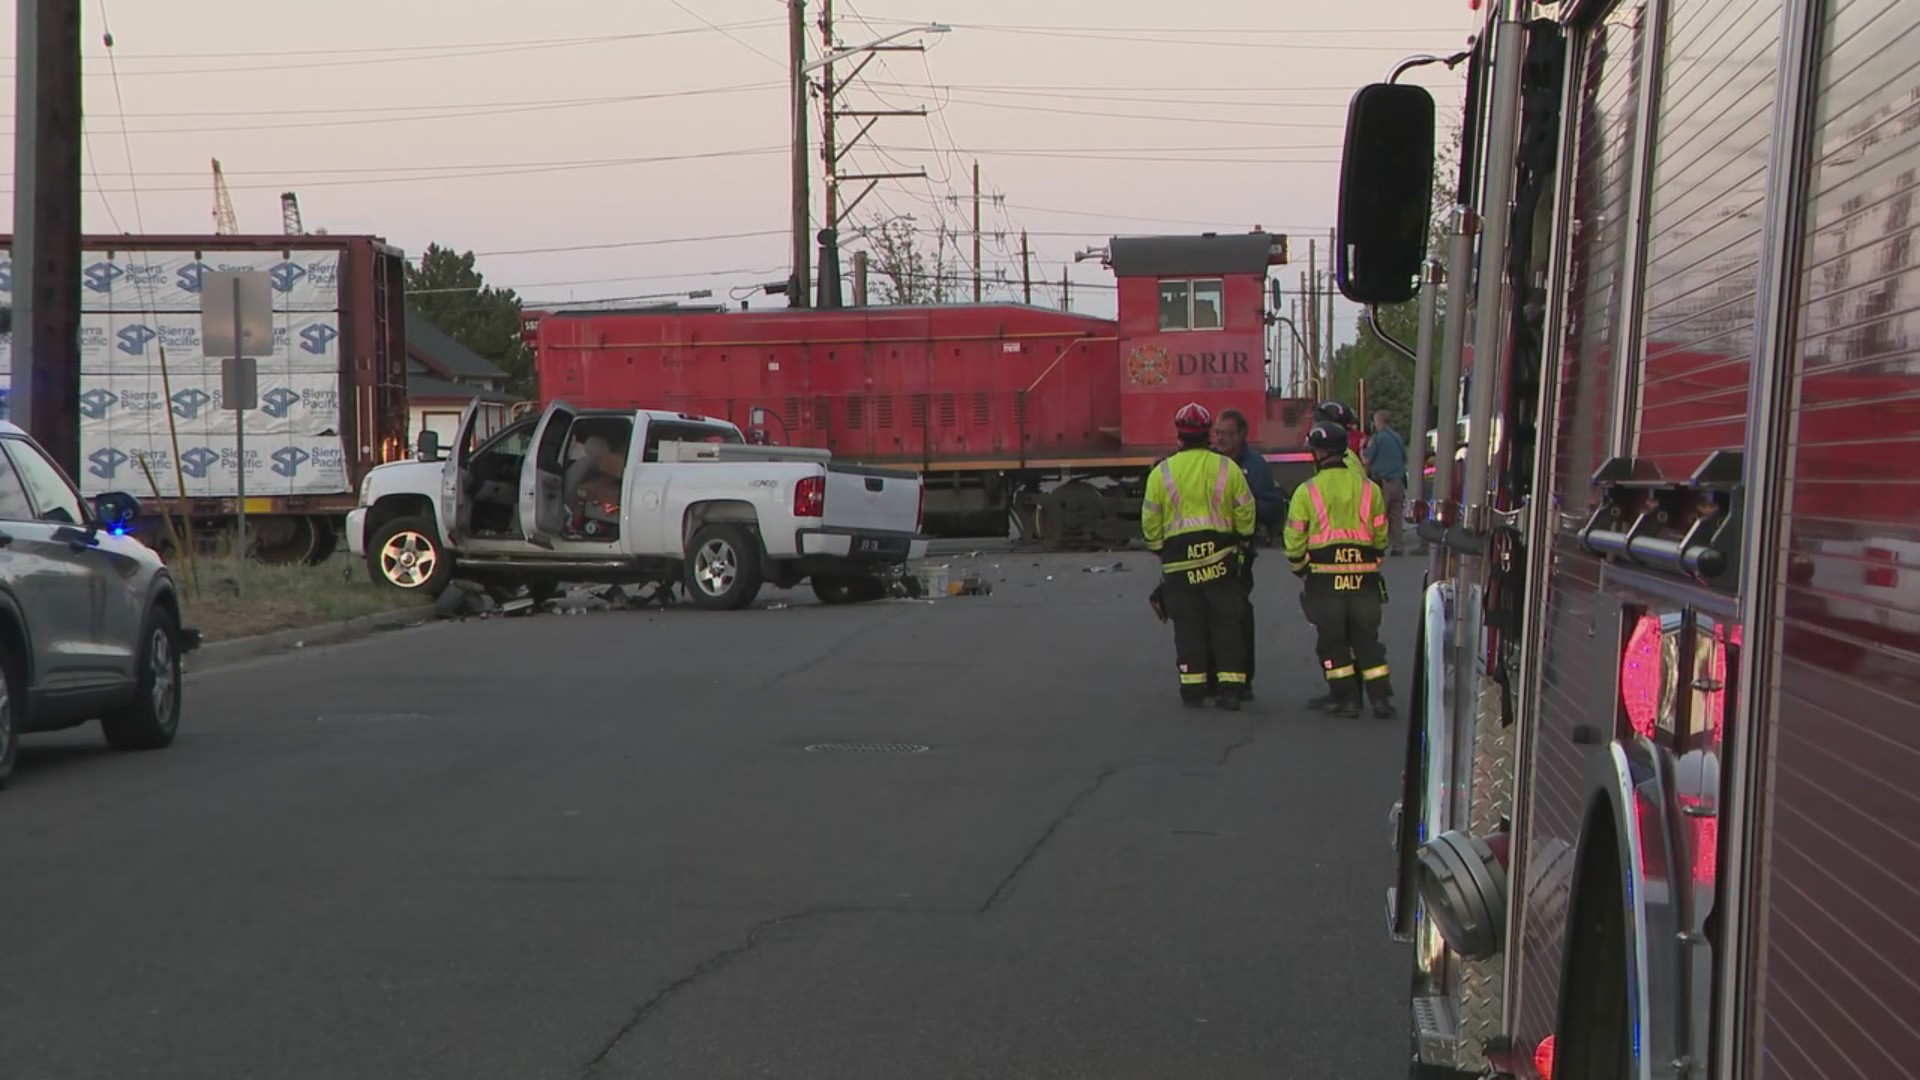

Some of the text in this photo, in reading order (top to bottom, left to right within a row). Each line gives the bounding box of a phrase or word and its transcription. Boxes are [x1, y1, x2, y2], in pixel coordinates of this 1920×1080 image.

[125, 264, 162, 273] Sierra
[308, 264, 339, 273] Sierr
[126, 274, 168, 284] Pacific
[158, 325, 194, 335] Sierra
[159, 337, 200, 346] Pacific
[1178, 352, 1249, 375] DRIR
[121, 390, 158, 400] Sierra
[121, 401, 162, 410] Pacific
[130, 448, 166, 458] Sierra
[312, 447, 340, 457] Sierr
[130, 459, 171, 469] Pacific
[1187, 541, 1215, 560] ACFR
[1334, 548, 1363, 564] ACFR
[1187, 562, 1227, 585] RAMOS
[1334, 575, 1363, 590] DALY
